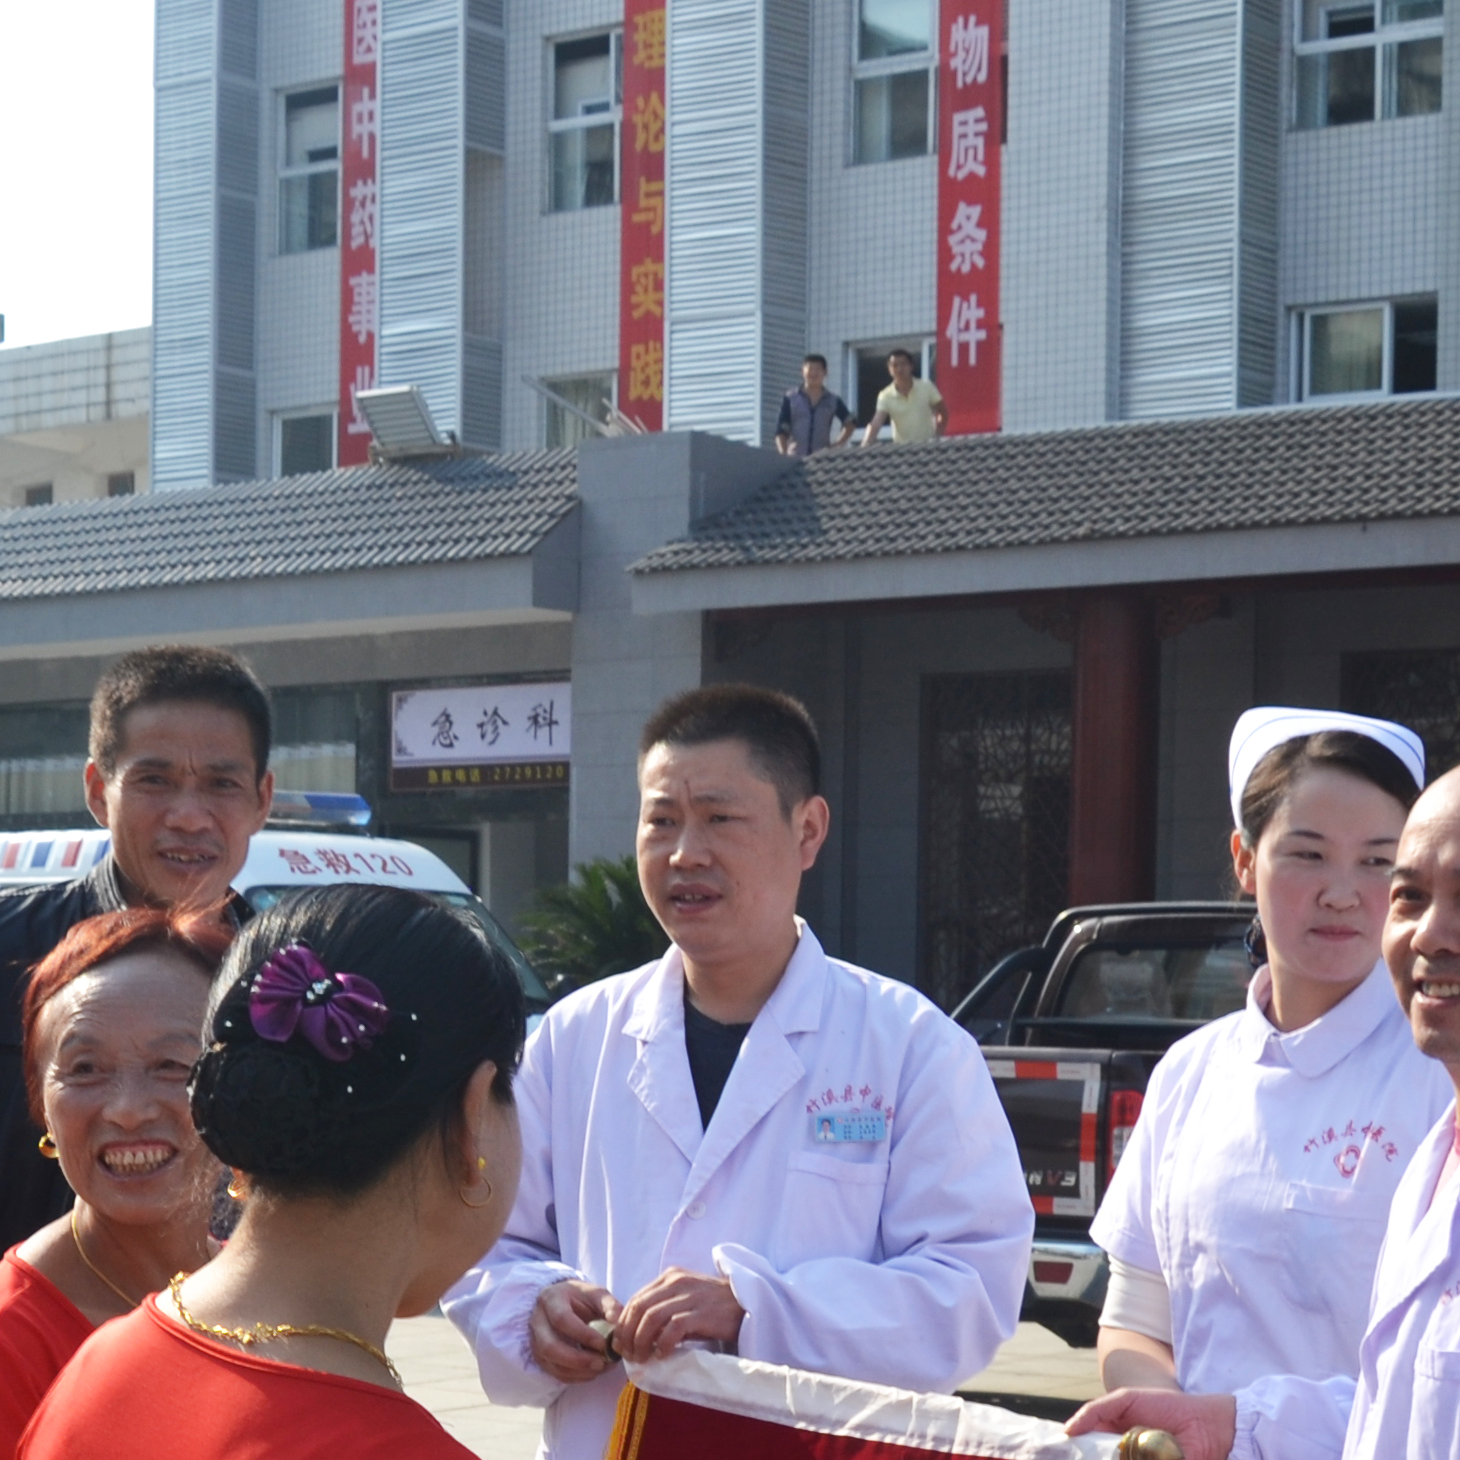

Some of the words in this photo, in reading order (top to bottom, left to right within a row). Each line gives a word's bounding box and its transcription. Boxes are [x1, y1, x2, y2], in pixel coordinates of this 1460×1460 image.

[629, 9, 665, 402] 理论与实践
[946, 14, 989, 368] 物质条件
[431, 699, 560, 749] 急诊科
[278, 848, 414, 876] 急救120
